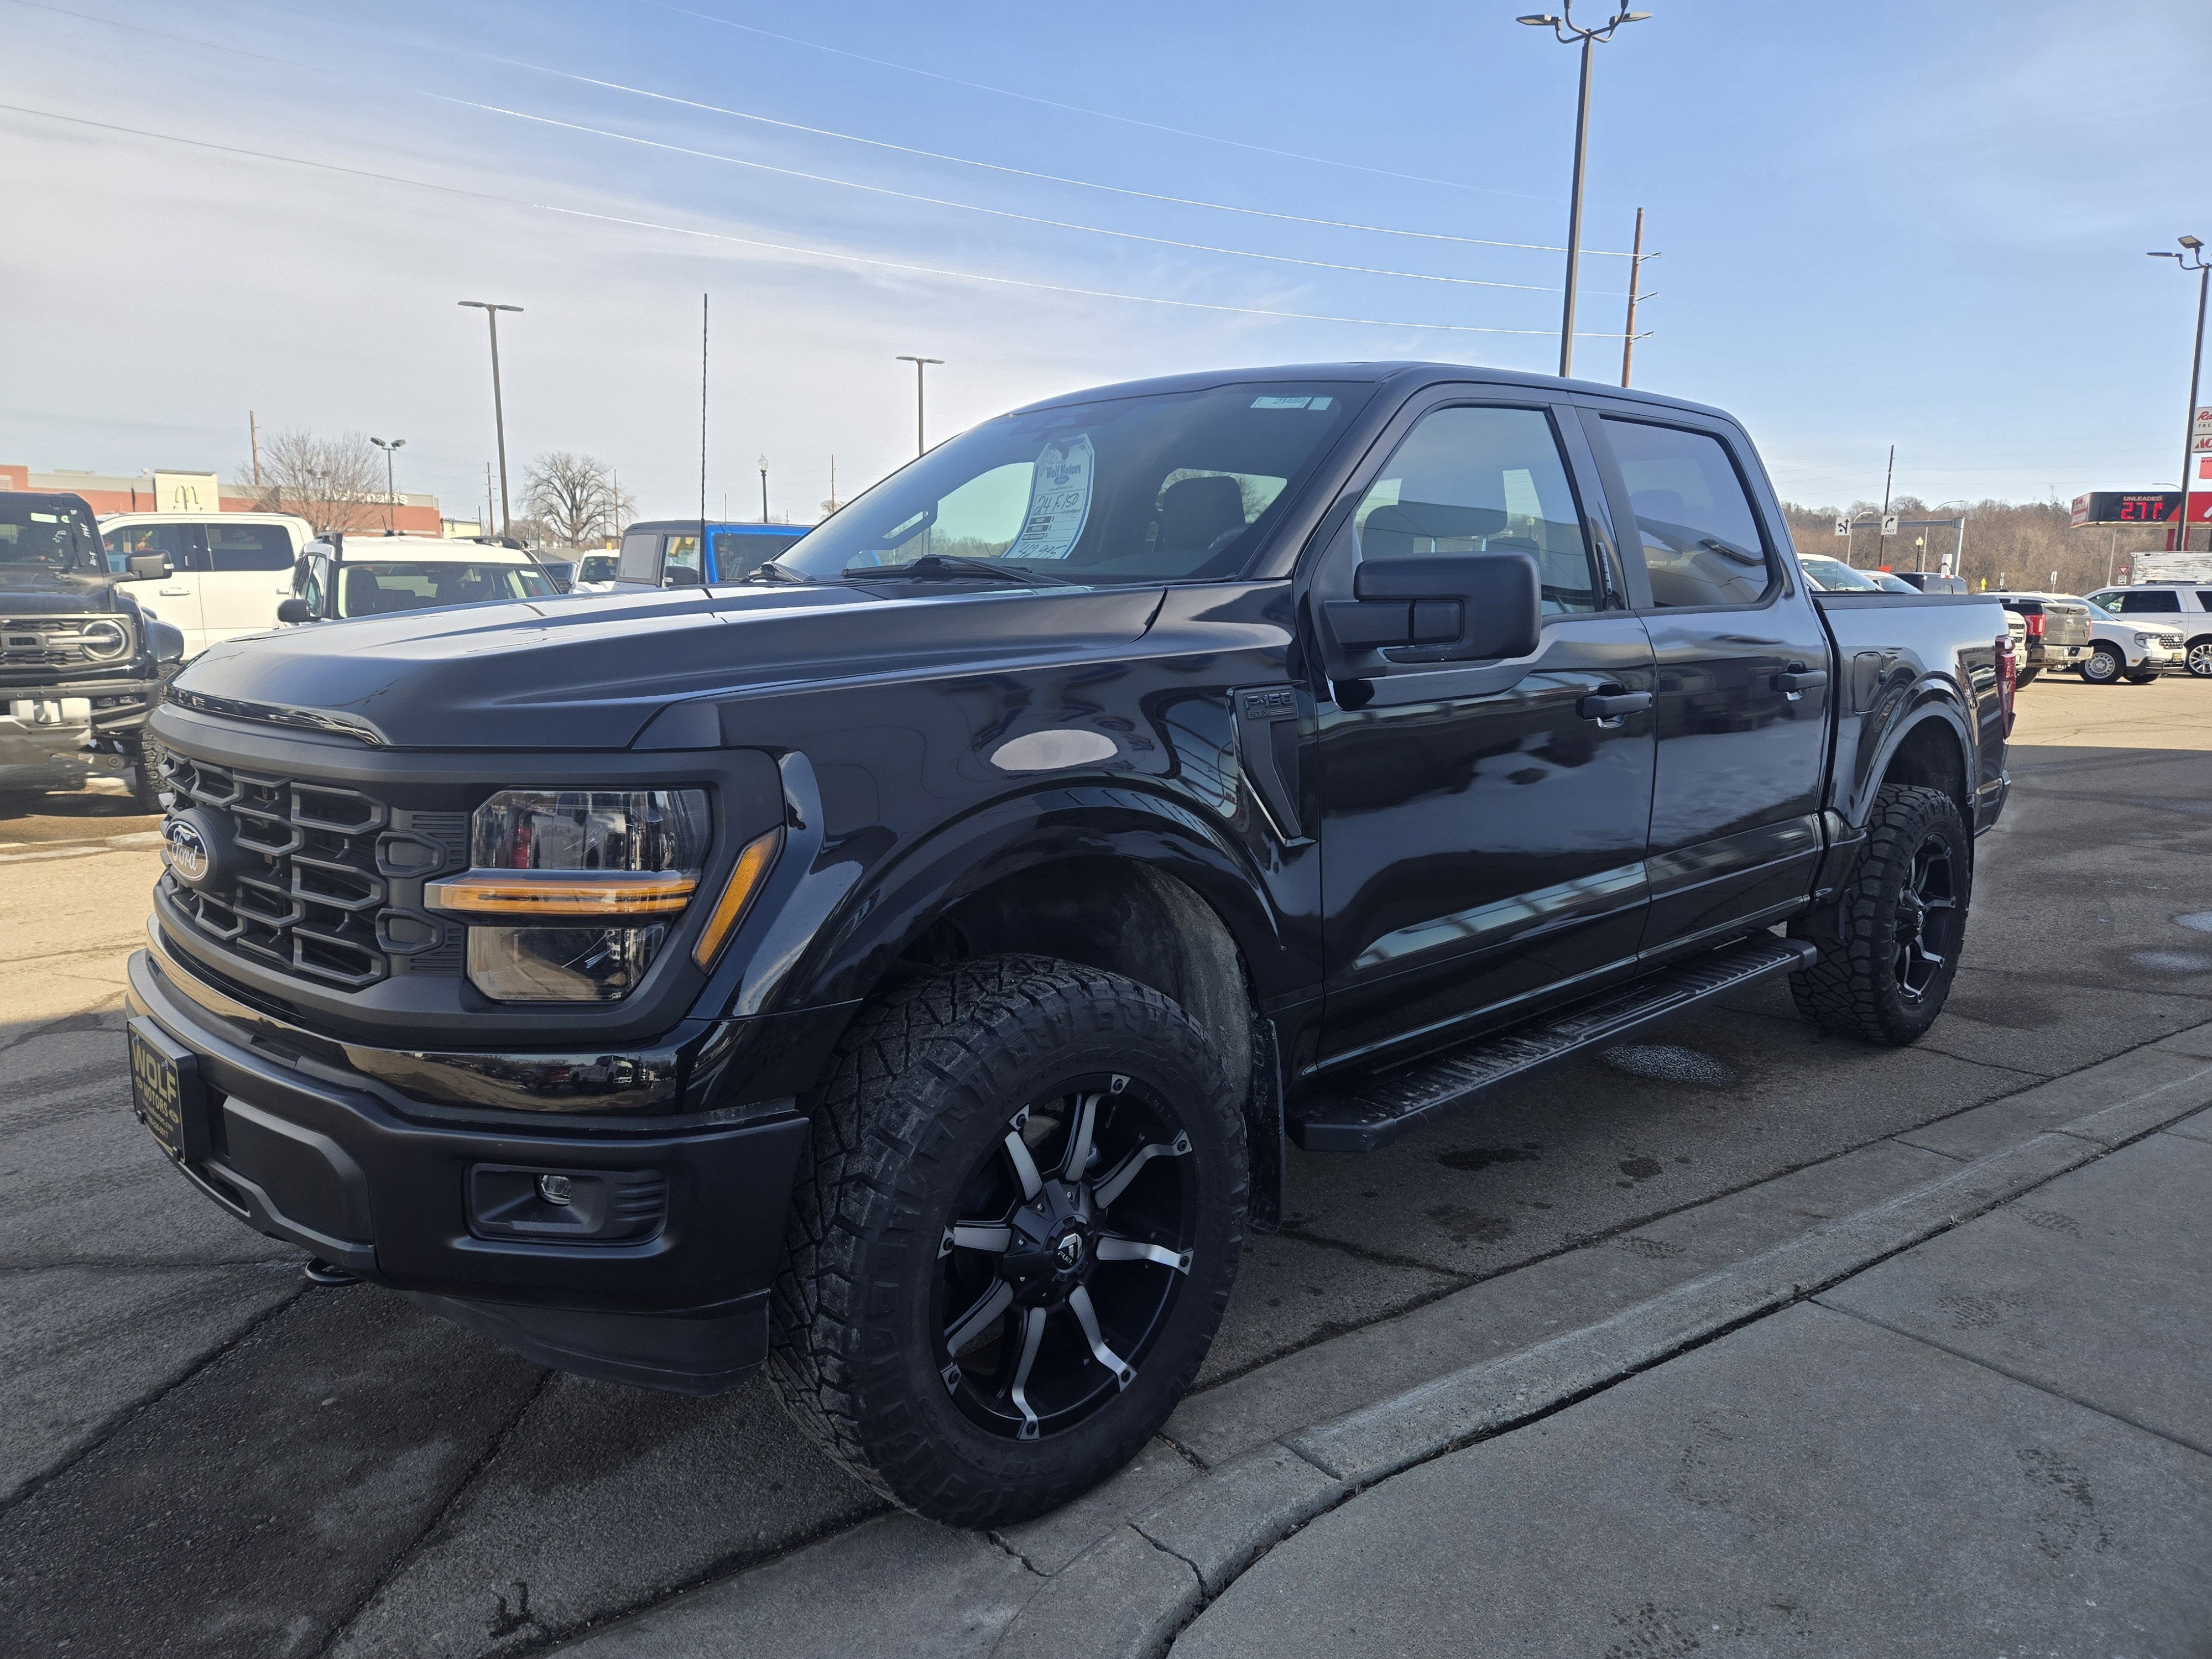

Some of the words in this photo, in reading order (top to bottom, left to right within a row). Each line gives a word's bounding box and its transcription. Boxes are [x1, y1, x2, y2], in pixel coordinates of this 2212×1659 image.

[172, 825, 199, 872] Ford
[132, 1039, 176, 1103] WOLF
[144, 1082, 168, 1118] MOTORS
[1057, 1250, 1073, 1266] FUEL
